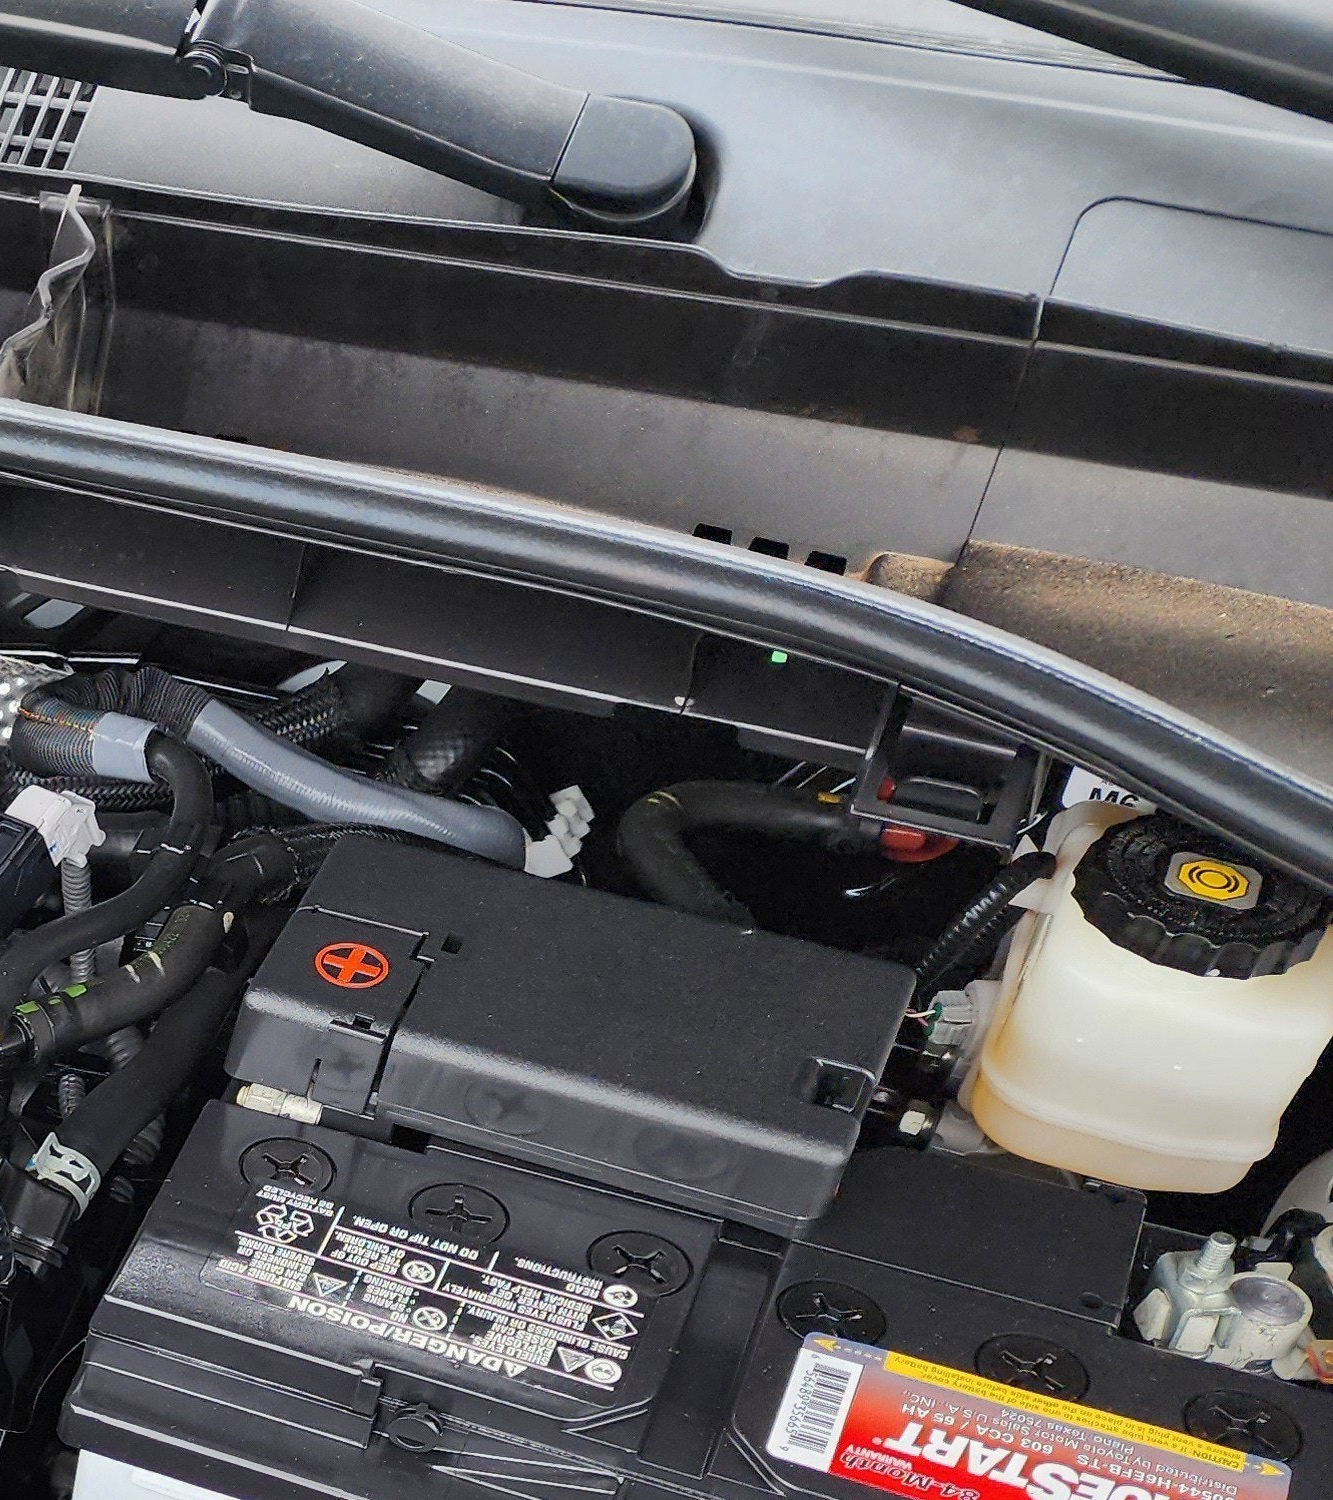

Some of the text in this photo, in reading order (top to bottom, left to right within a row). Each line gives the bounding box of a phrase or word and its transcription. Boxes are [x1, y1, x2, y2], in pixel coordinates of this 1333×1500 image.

[286, 1294, 503, 1372] DANGER/POISON
[901, 1402, 929, 1420] AH
[932, 1411, 955, 1427] 65
[974, 1423, 1015, 1444] CCA
[991, 1416, 1030, 1435] Sales
[1019, 1436, 1053, 1455] 603
[1033, 1428, 1079, 1449] Motor
[845, 1443, 913, 1469] WARRANTY
[1082, 1440, 1132, 1465] Toyota
[1155, 1463, 1238, 1495] Distributed
